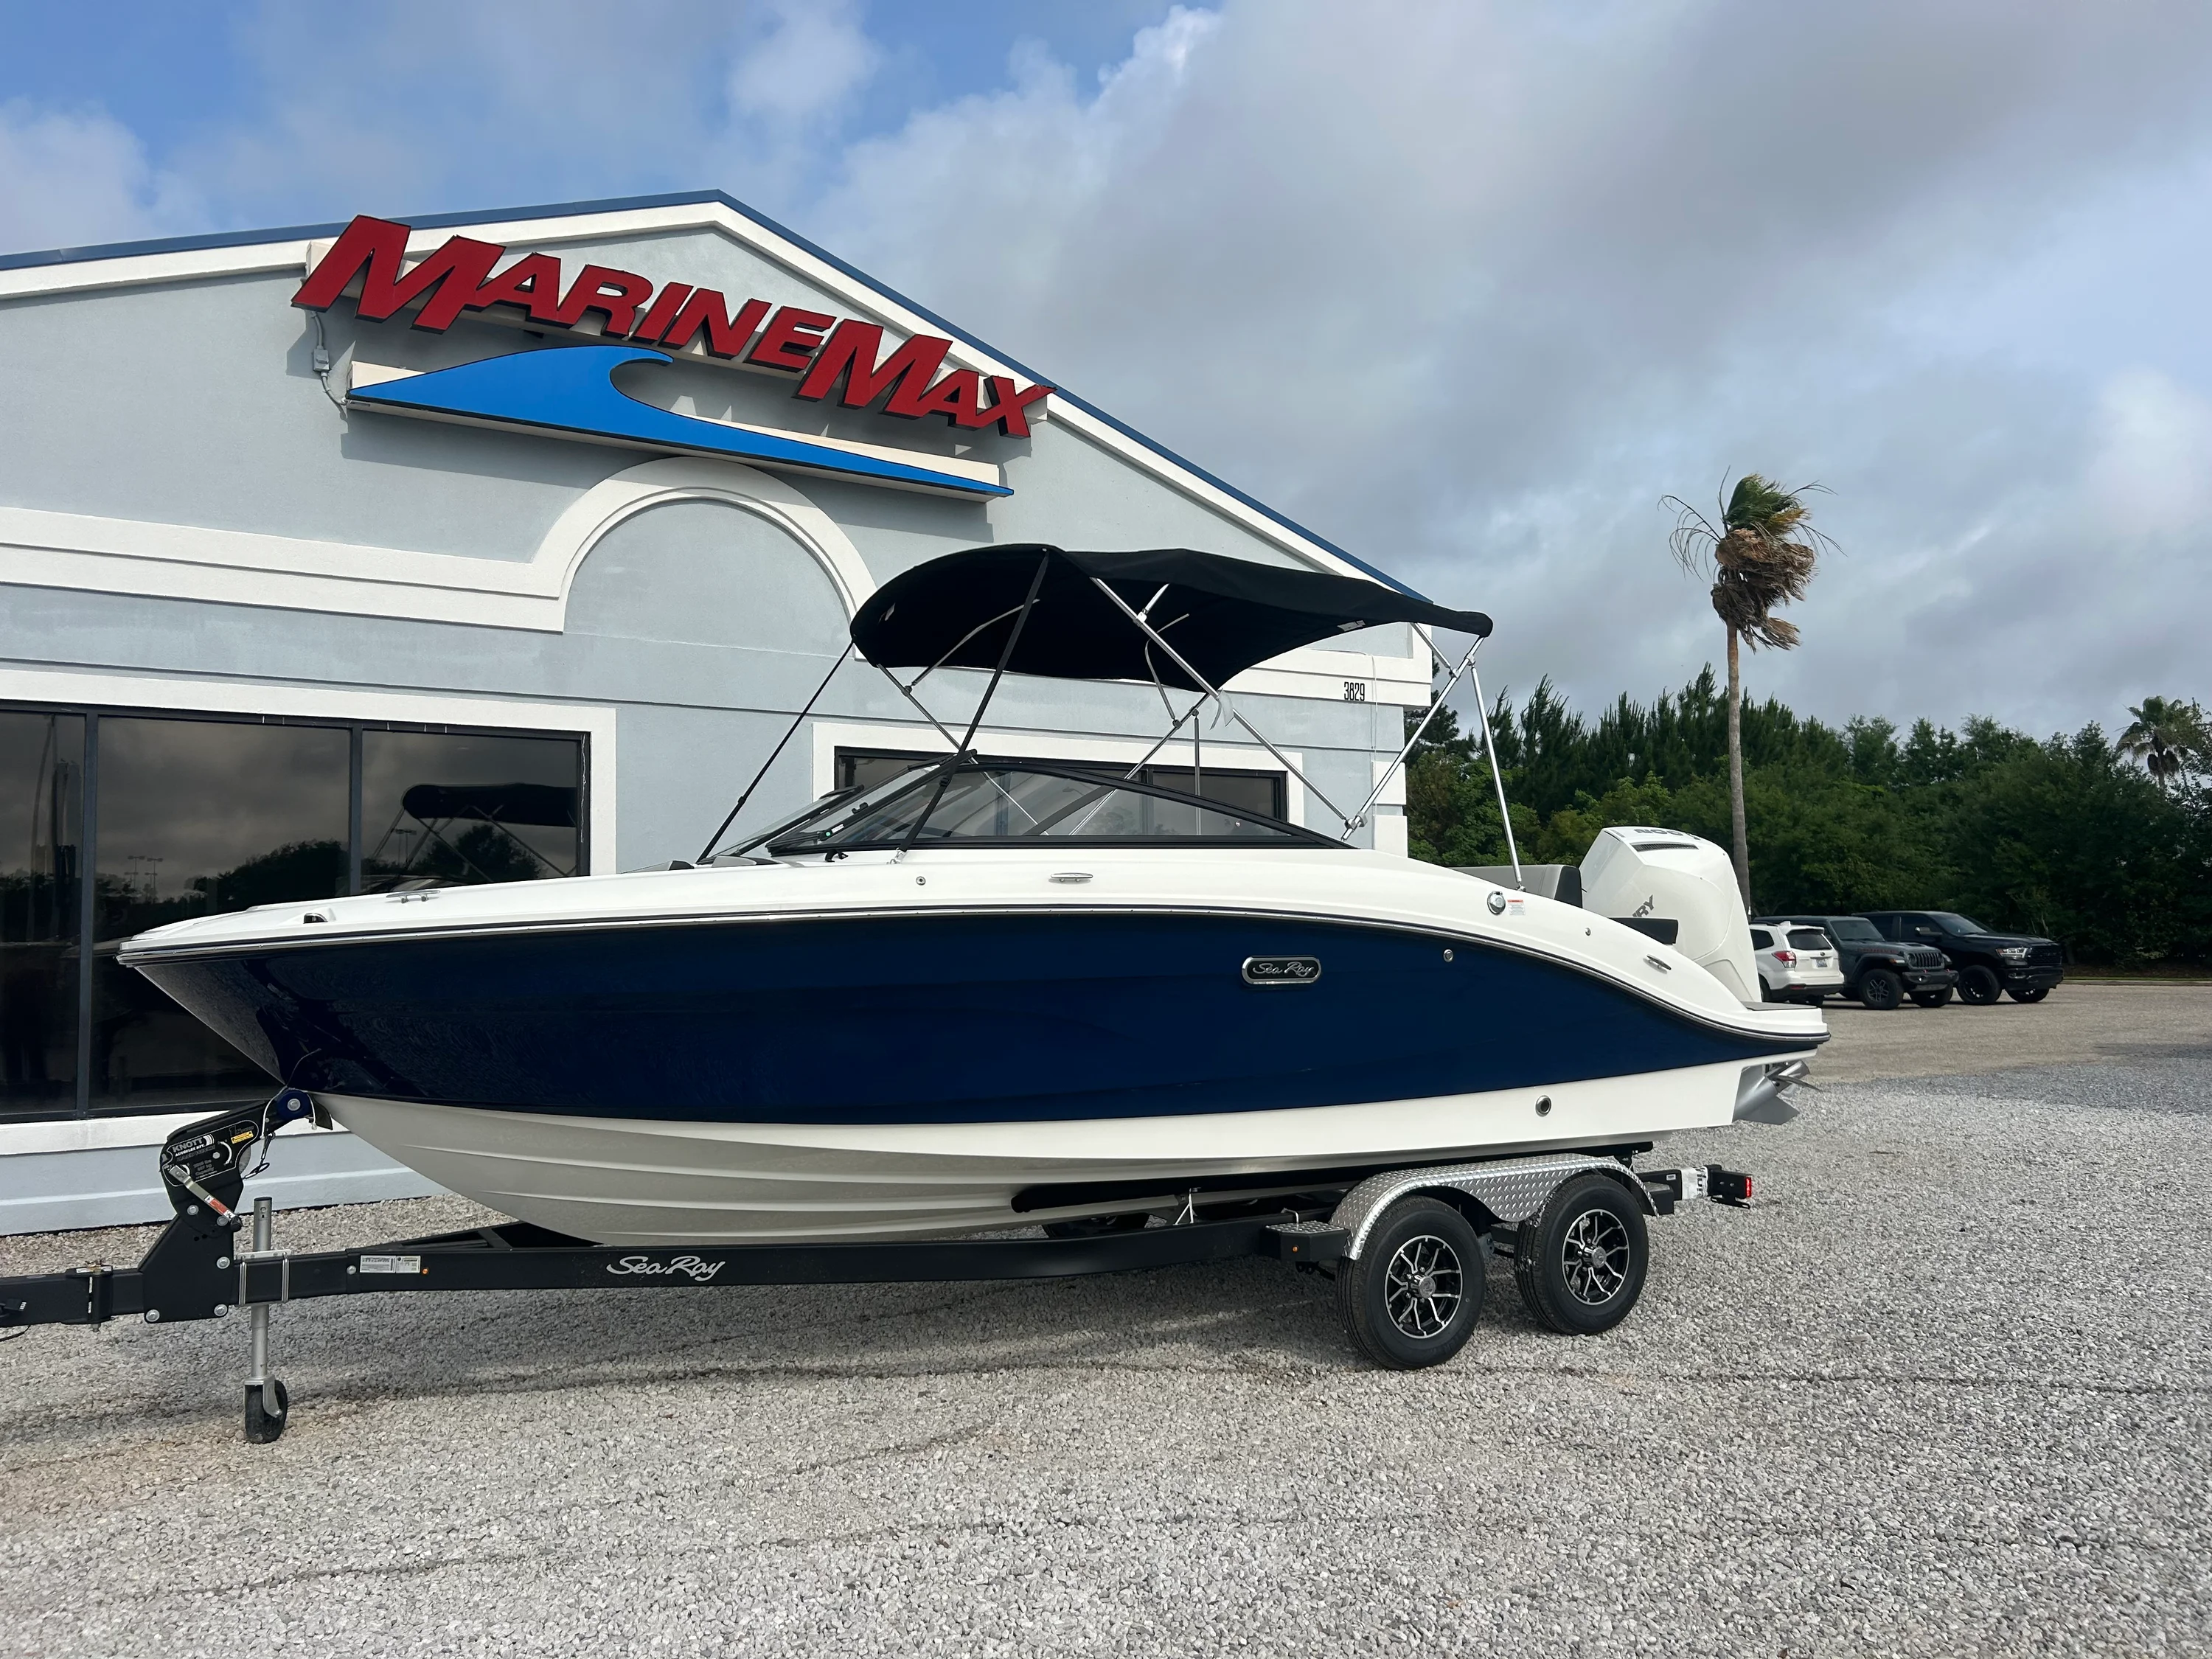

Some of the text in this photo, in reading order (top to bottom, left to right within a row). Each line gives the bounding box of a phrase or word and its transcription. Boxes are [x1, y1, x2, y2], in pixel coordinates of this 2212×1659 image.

[1343, 681, 1366, 702] 3829
[1252, 961, 1314, 977] Sea Ray
[172, 1137, 203, 1152] KNOTT
[606, 1255, 726, 1281] Sea Ray
